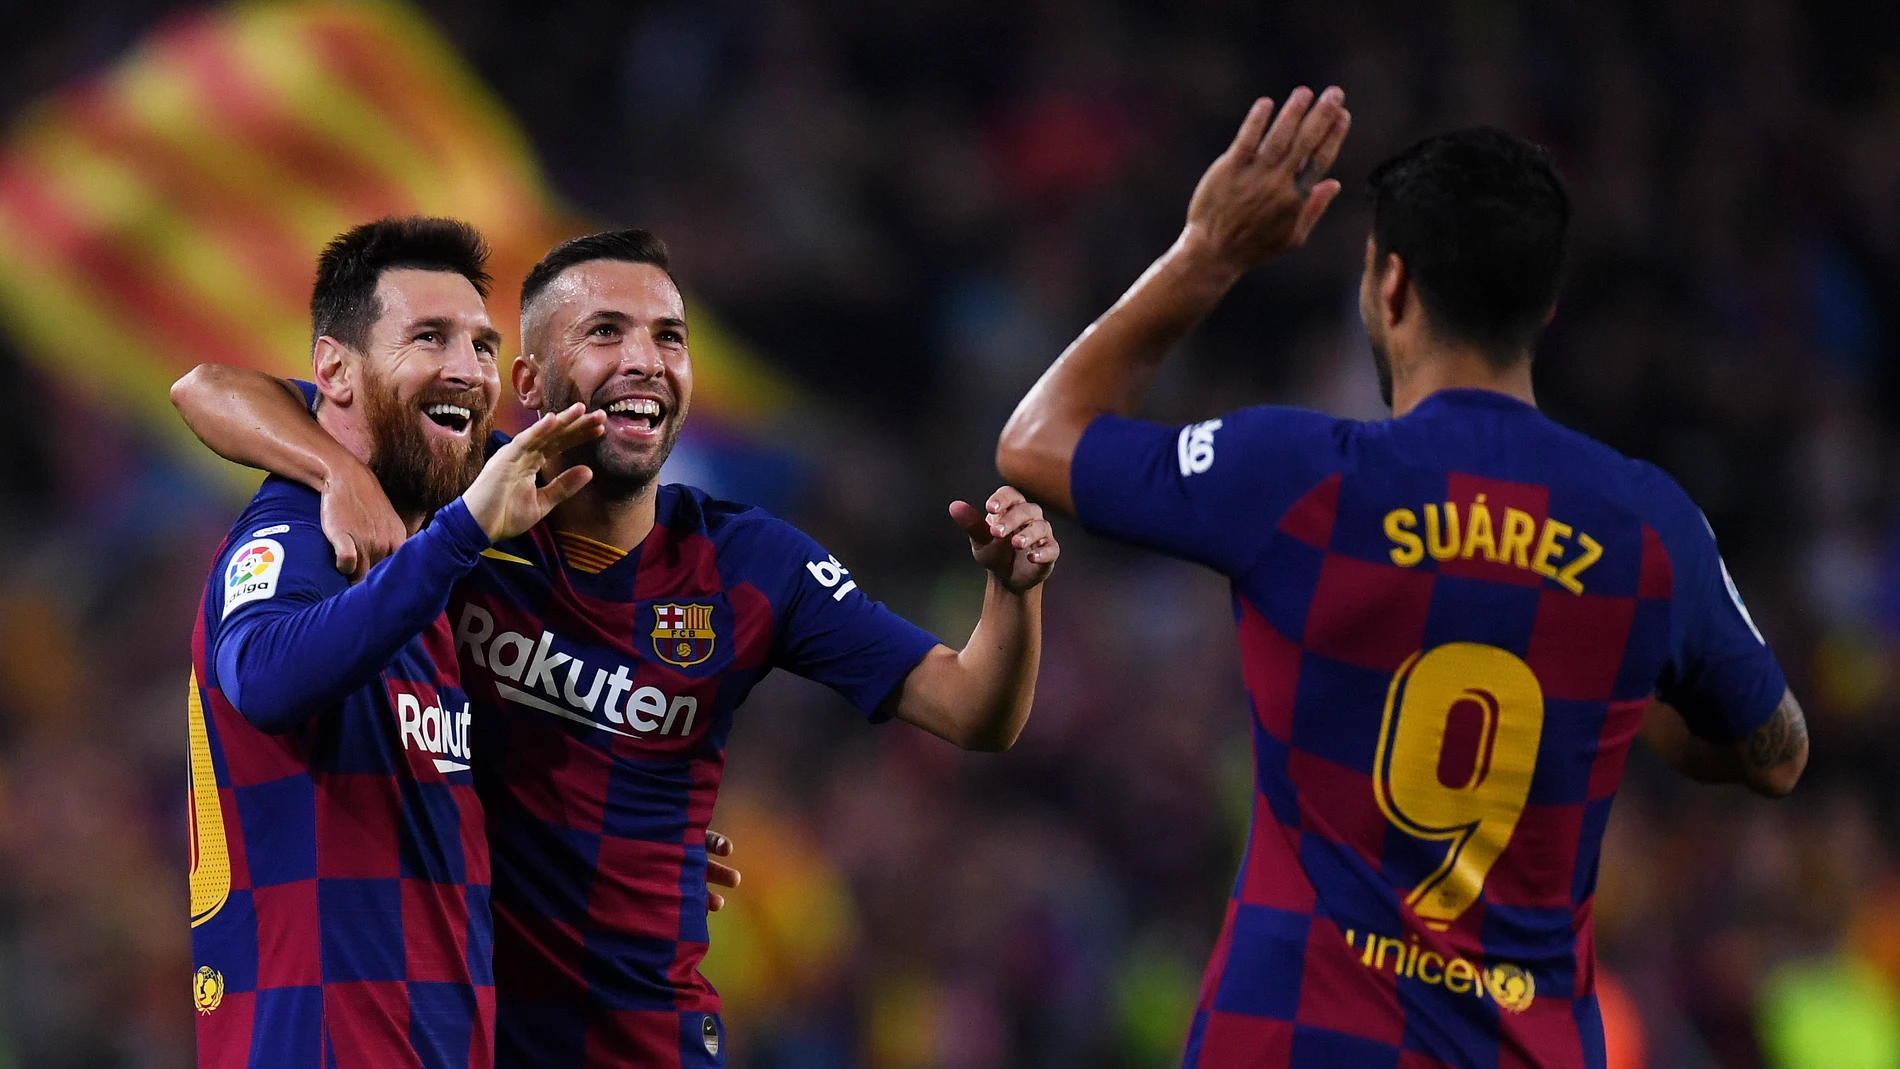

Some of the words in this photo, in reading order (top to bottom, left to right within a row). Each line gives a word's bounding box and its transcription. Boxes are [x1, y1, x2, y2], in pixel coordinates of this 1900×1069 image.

[1383, 493, 1604, 597] SUÁREZ
[456, 602, 698, 737] Rakuten
[671, 630, 696, 638] FCB
[1372, 641, 1545, 931] 9
